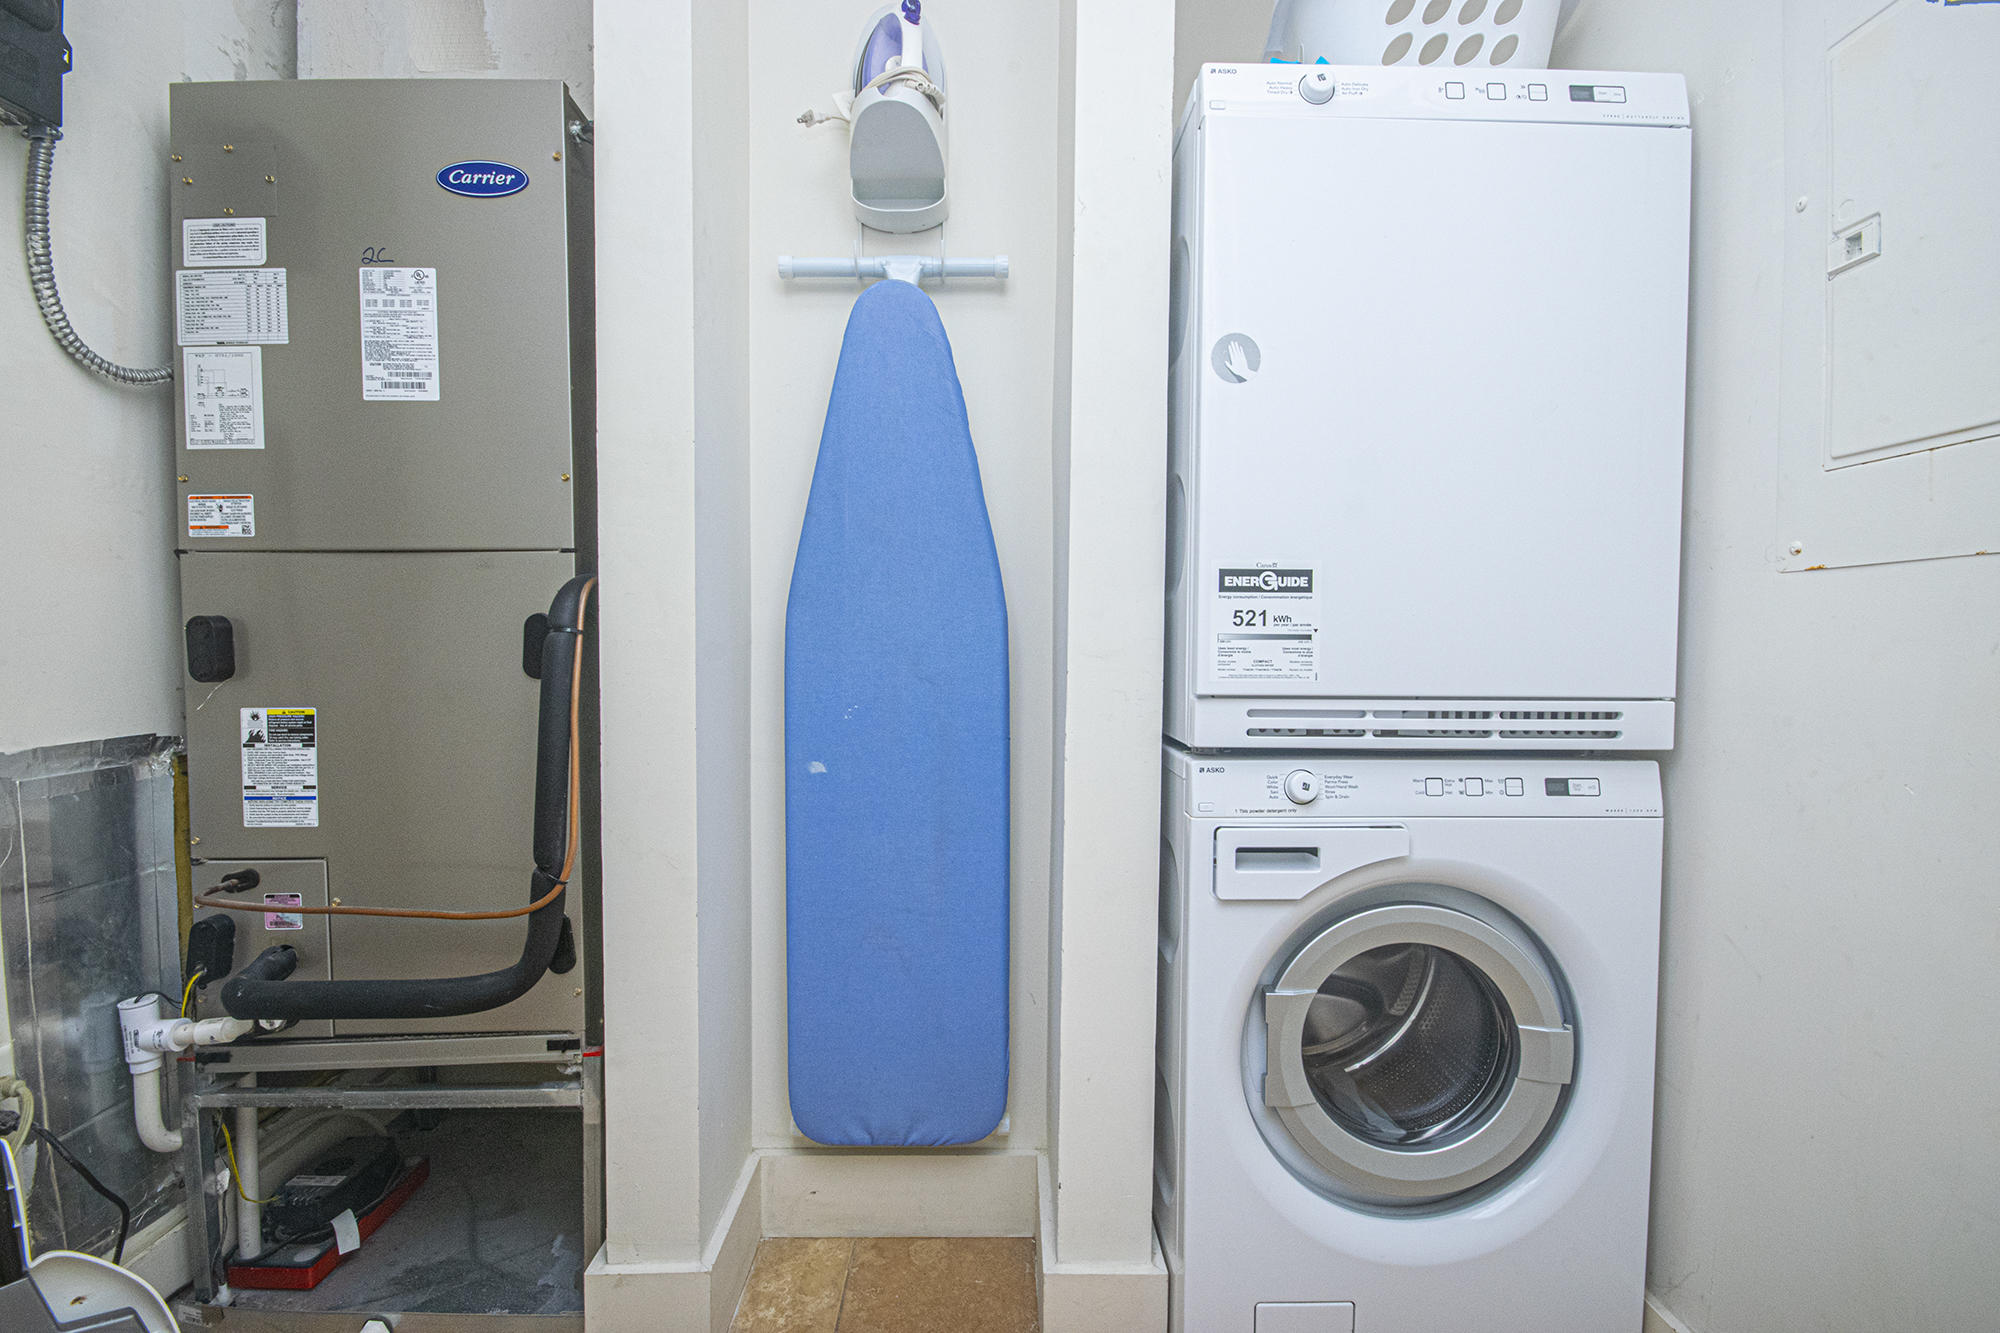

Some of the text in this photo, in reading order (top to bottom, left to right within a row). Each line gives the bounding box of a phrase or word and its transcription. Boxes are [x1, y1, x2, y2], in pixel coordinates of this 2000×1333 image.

[449, 169, 516, 185] Carrier
[1224, 571, 1309, 591] ENERGUIDE
[1232, 610, 1291, 627] 521 kWh
